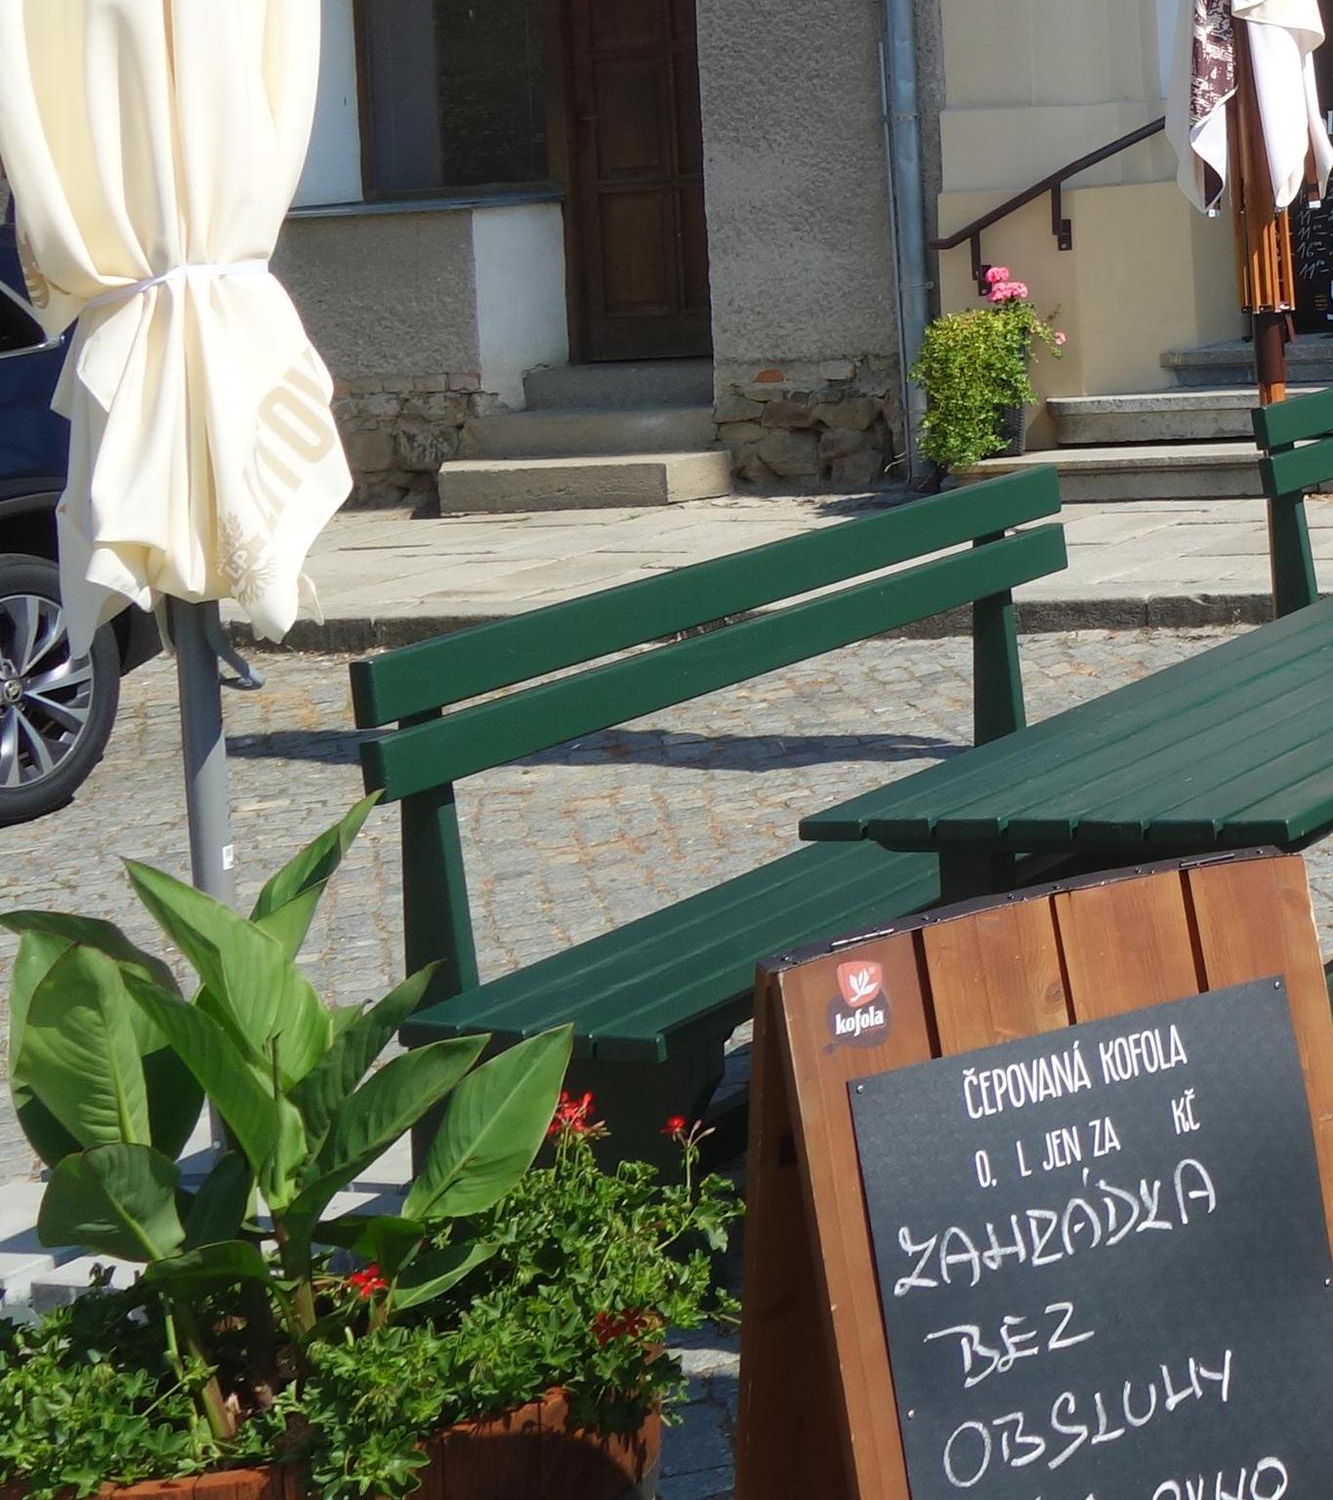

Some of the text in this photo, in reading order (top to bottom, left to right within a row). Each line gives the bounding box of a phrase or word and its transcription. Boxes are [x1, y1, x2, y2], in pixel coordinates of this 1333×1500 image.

[835, 1005, 885, 1037] kofola
[963, 1024, 1188, 1119] ČEPOVANÁ KOFOLA
[1015, 1140, 1032, 1177] L
[1042, 1125, 1082, 1171] JEN
[1088, 1116, 1121, 1158] ZA
[923, 1301, 1095, 1388] BEZ
